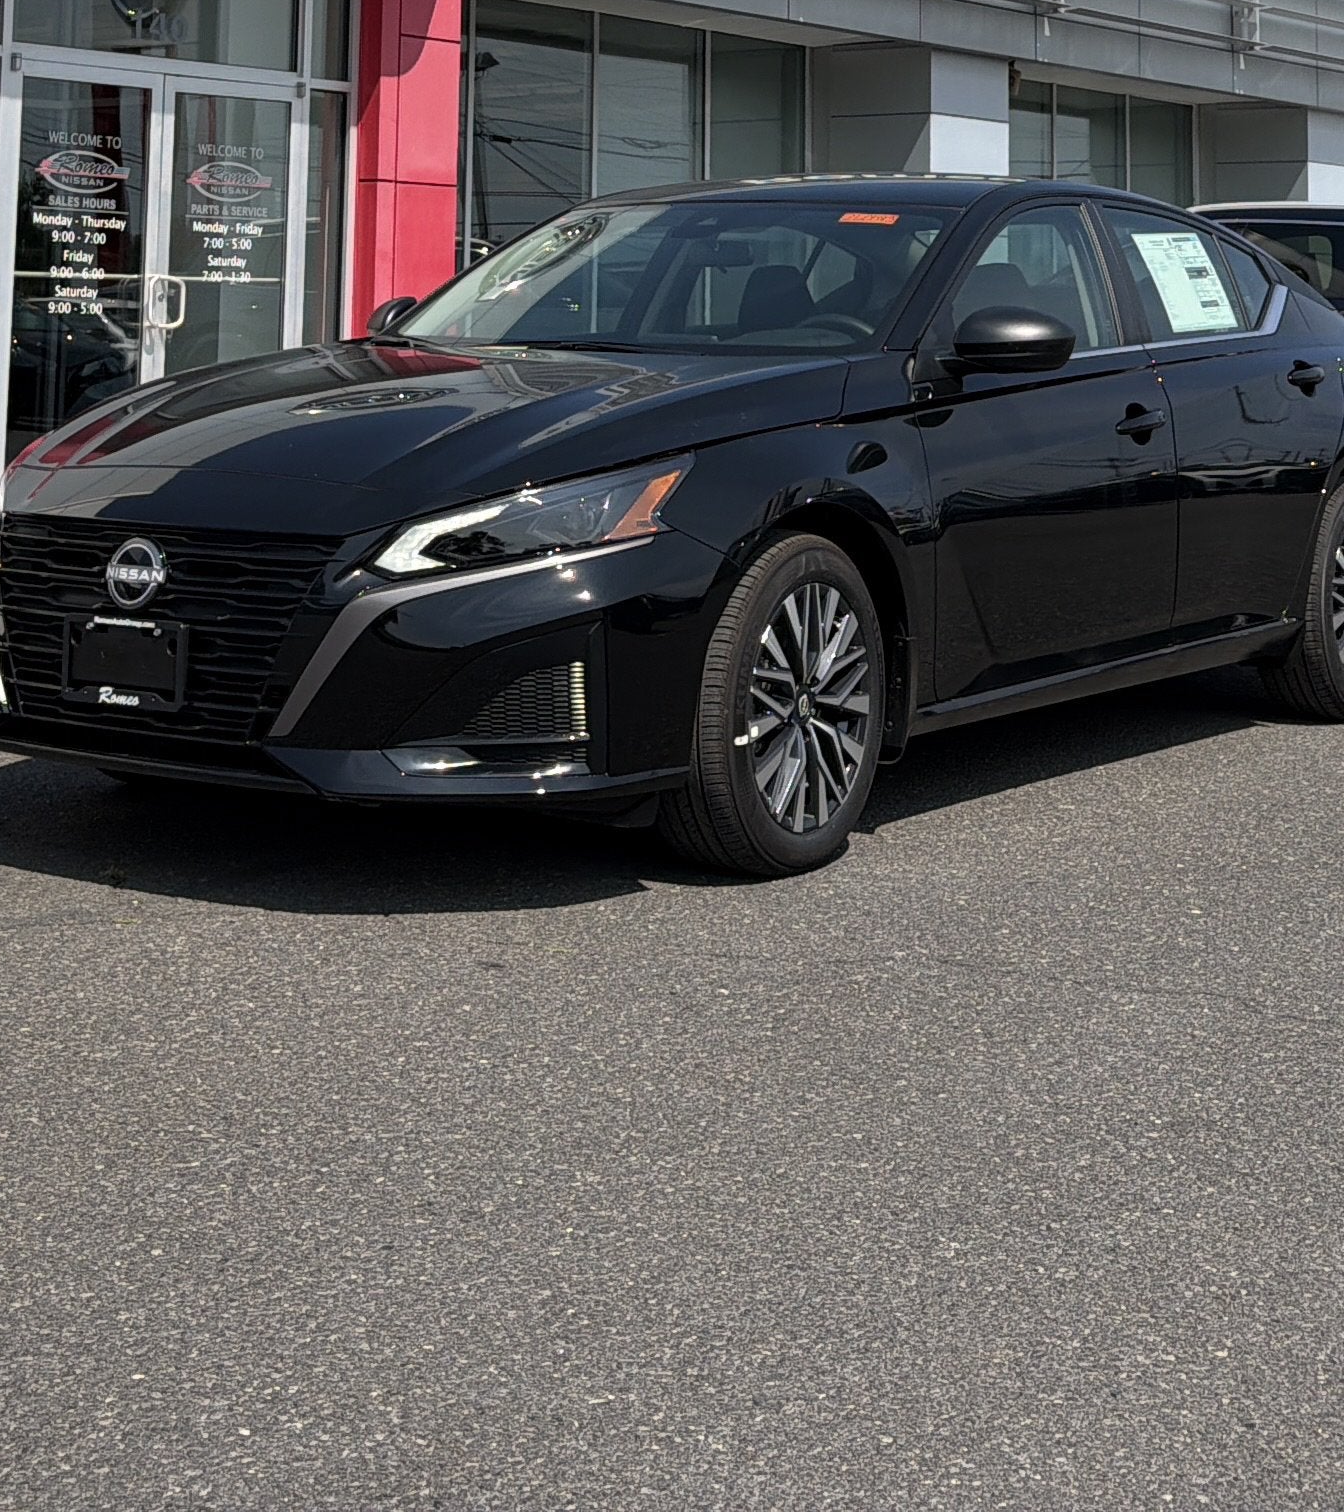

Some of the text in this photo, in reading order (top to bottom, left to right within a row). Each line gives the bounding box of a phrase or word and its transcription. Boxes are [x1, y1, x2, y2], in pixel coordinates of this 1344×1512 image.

[48, 130, 122, 149] WELCOME TO
[198, 144, 264, 160] WELCOME TO
[56, 154, 115, 176] Romeo
[61, 176, 105, 186] NISSAN
[206, 165, 260, 184] Romeo
[210, 185, 249, 195] NISSAN
[48, 195, 117, 209] SALES HOURS
[191, 204, 268, 217] PARTS & SERVICE
[32, 212, 73, 228] Monday
[81, 215, 127, 231] Thursday
[192, 221, 229, 235] Monday
[236, 223, 263, 237] Friday
[51, 230, 75, 243] 9:00
[84, 232, 107, 244] 7:00
[203, 237, 224, 248] 7:00
[232, 238, 252, 250] 5:00
[63, 249, 94, 265] Friday
[207, 255, 247, 269] Saturday
[49, 266, 73, 278] 9:00
[81, 267, 105, 279] 6:00
[202, 271, 223, 282] 7:00
[231, 271, 251, 283] 1:30
[54, 285, 98, 300] Saturday
[48, 301, 71, 314] 9:00
[80, 302, 103, 315] 5:00
[106, 563, 164, 582] NISSAN
[98, 686, 140, 706] Romeo
